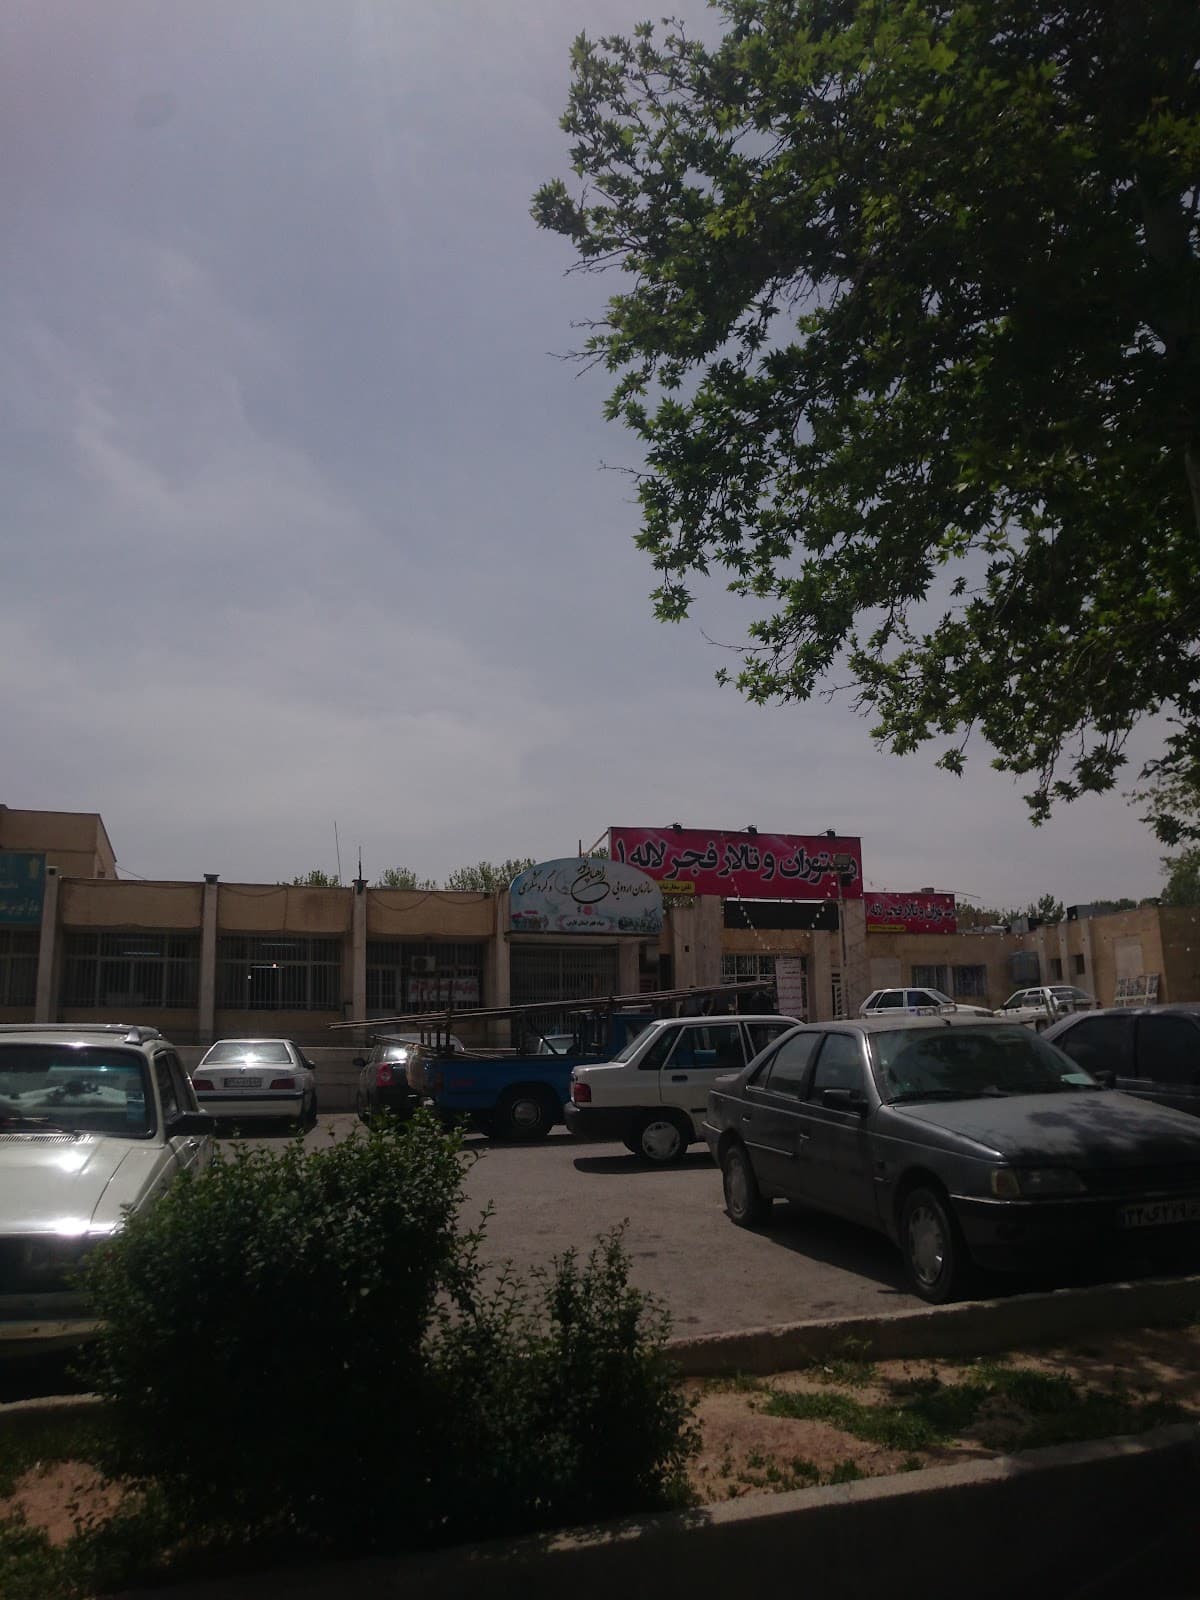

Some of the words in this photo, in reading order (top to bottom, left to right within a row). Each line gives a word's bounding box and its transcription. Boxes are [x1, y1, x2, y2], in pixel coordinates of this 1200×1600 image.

[630, 840, 665, 867] لاله
[663, 841, 718, 879] فجر
[718, 843, 760, 877] تالار
[762, 852, 775, 880] و
